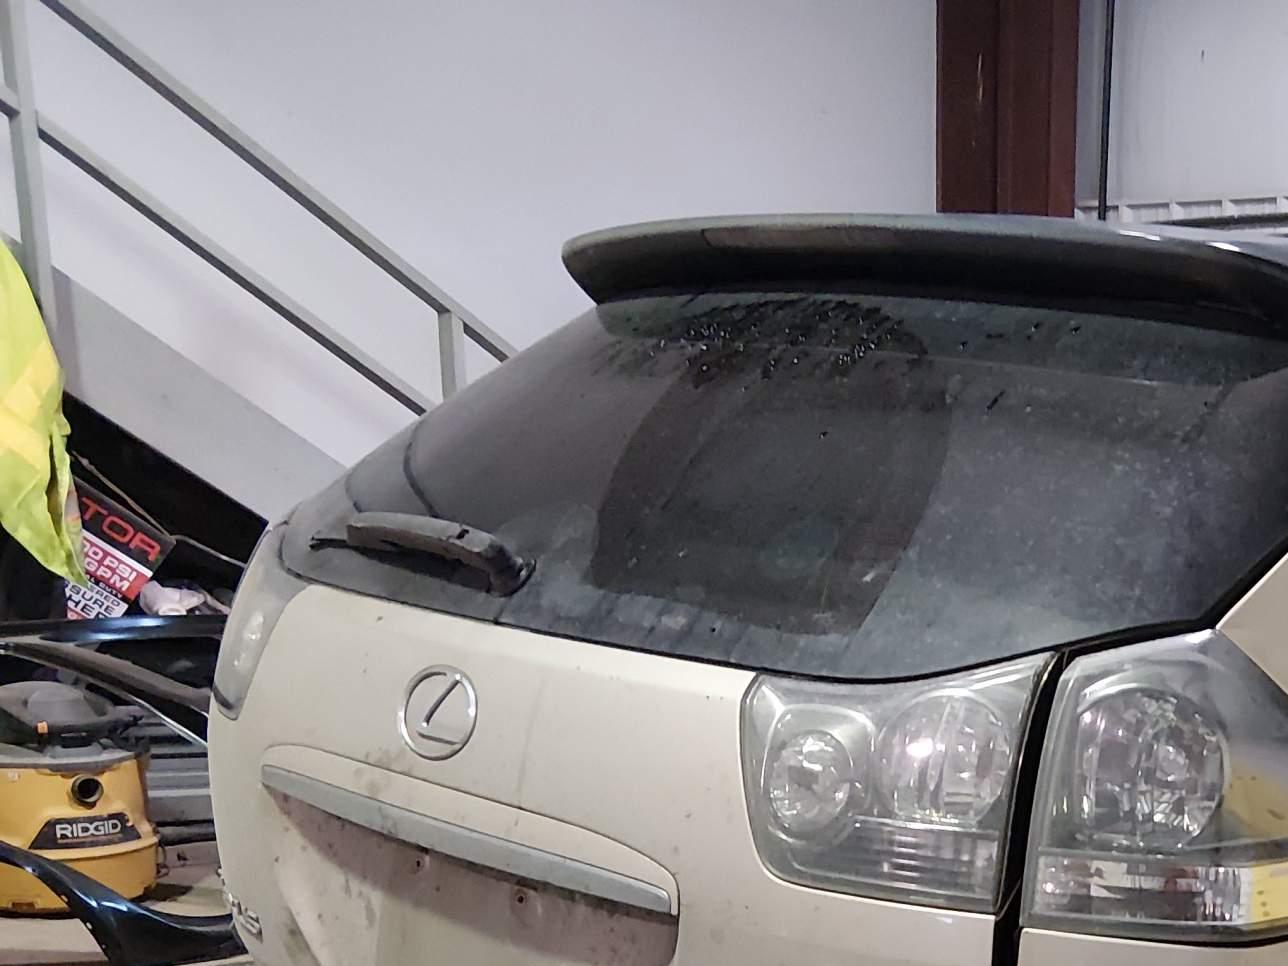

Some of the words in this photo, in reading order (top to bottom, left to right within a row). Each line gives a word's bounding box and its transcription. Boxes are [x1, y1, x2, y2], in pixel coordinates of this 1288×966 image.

[85, 558, 131, 592] GPM
[103, 552, 137, 582] PSI
[55, 819, 122, 839] RIDGID
